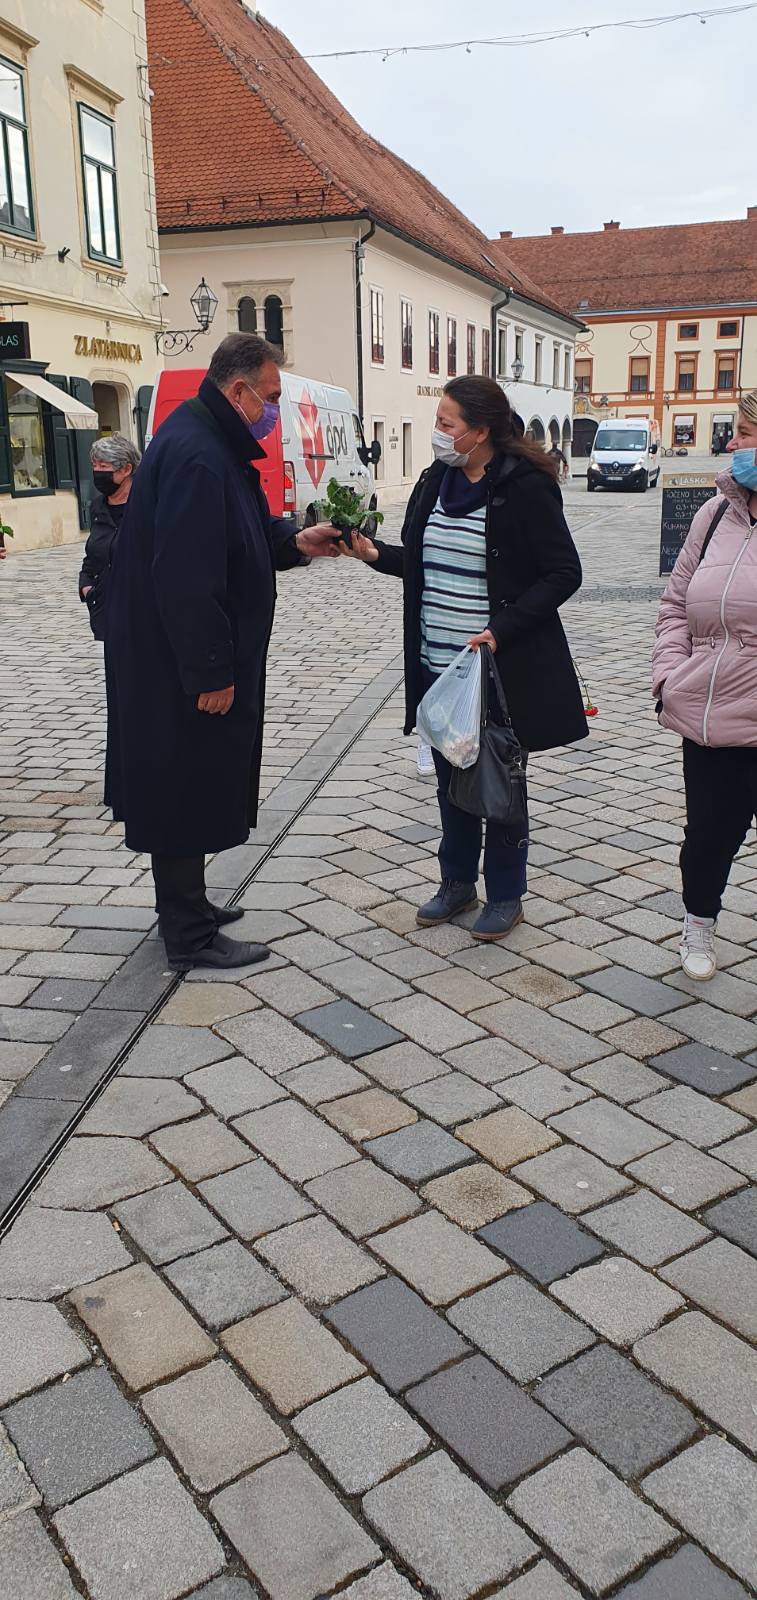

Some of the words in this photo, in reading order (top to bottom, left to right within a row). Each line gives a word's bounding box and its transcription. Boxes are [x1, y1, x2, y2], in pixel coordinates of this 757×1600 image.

[0, 335, 19, 346] LAS
[74, 335, 143, 363] ZLATARNICA
[326, 413, 348, 466] dpd
